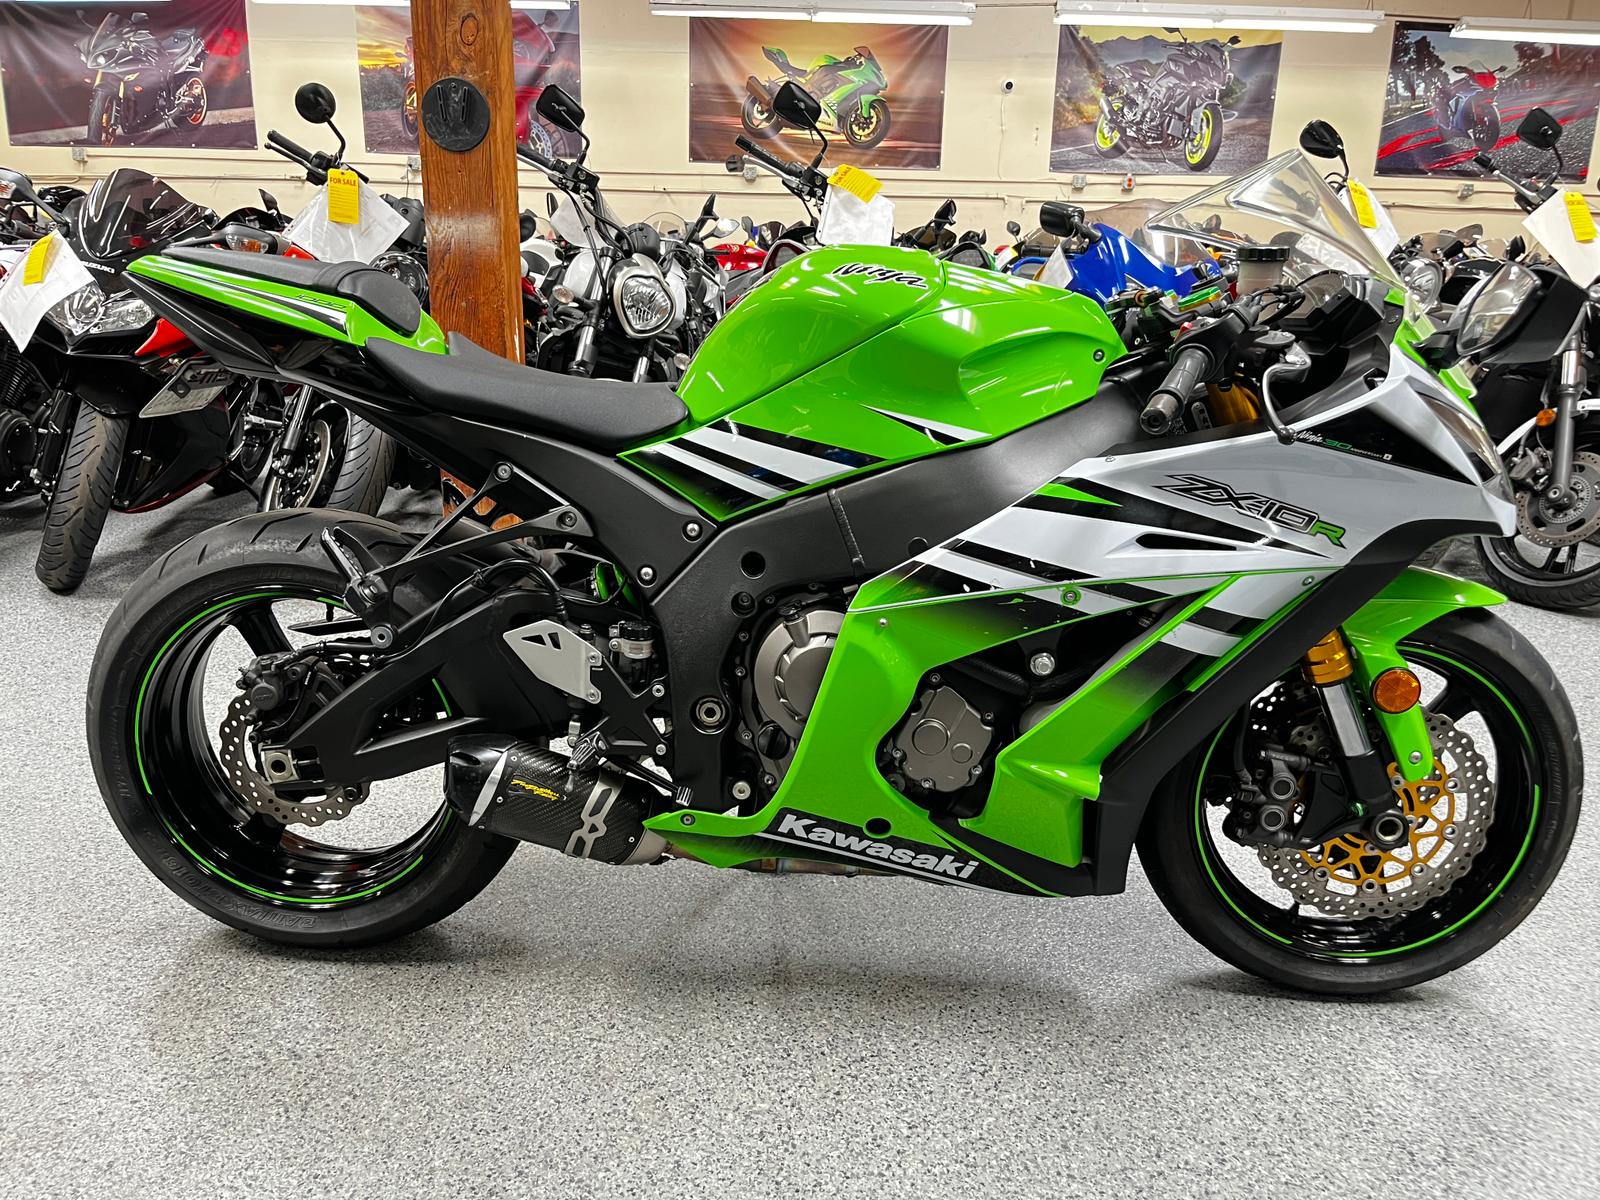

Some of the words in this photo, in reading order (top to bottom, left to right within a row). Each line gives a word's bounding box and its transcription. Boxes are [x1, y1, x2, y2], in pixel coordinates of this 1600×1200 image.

[329, 177, 341, 185] FOR
[342, 178, 356, 186] SALE
[832, 262, 928, 289] Ninja
[778, 813, 979, 879] Kawasaki
